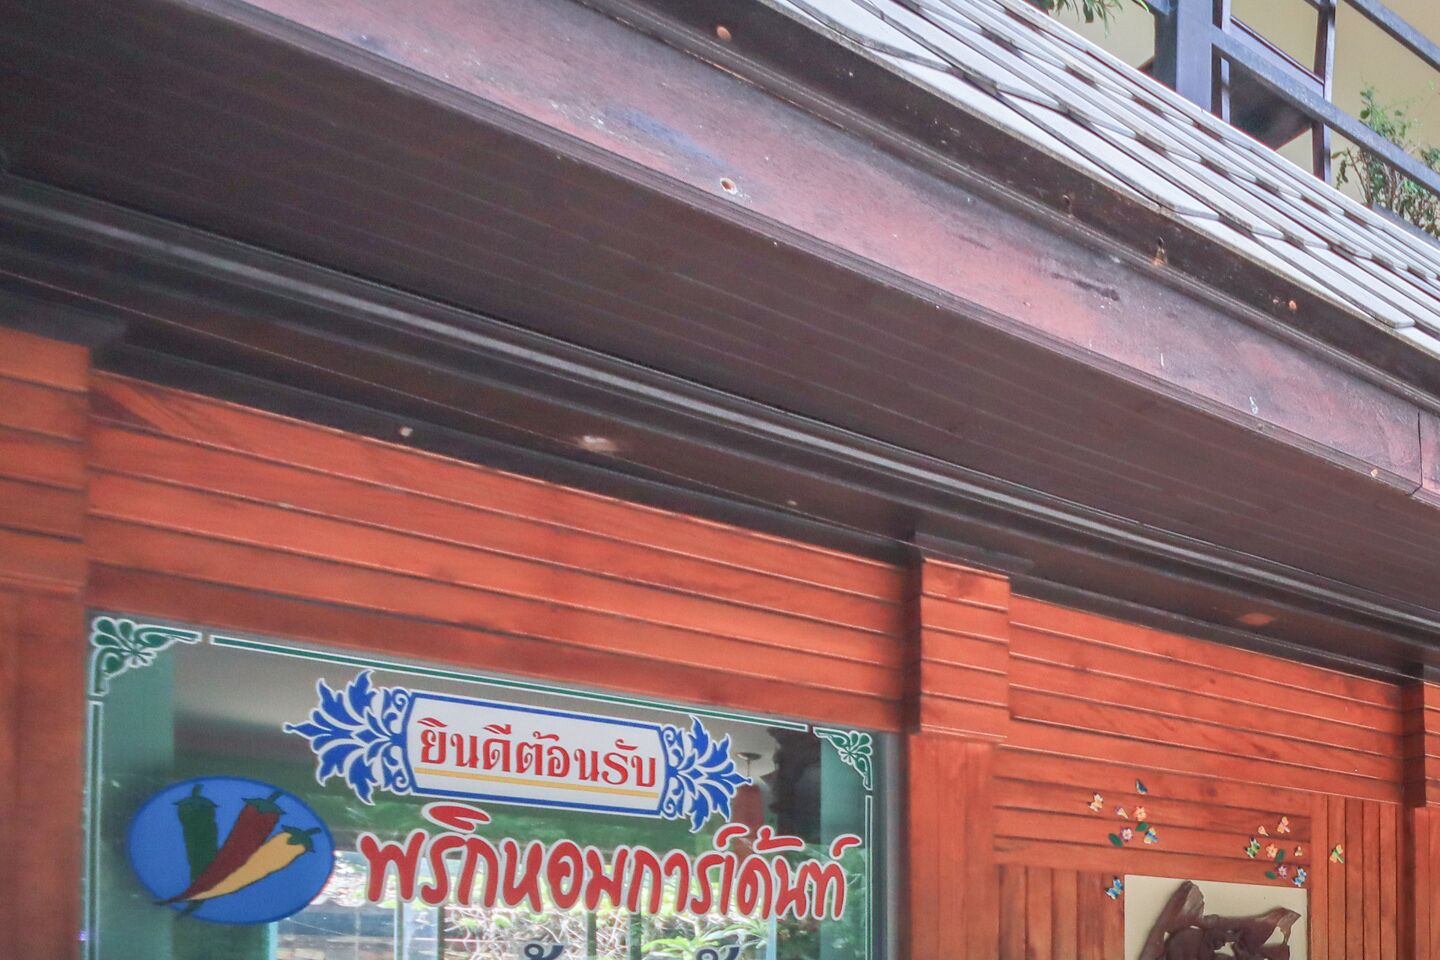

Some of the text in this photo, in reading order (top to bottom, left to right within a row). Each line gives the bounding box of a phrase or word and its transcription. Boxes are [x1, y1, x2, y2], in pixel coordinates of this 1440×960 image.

[416, 716, 657, 788] ยินดีต้อนรับ
[358, 801, 862, 920] พริกหอมการ์เด้นท์
